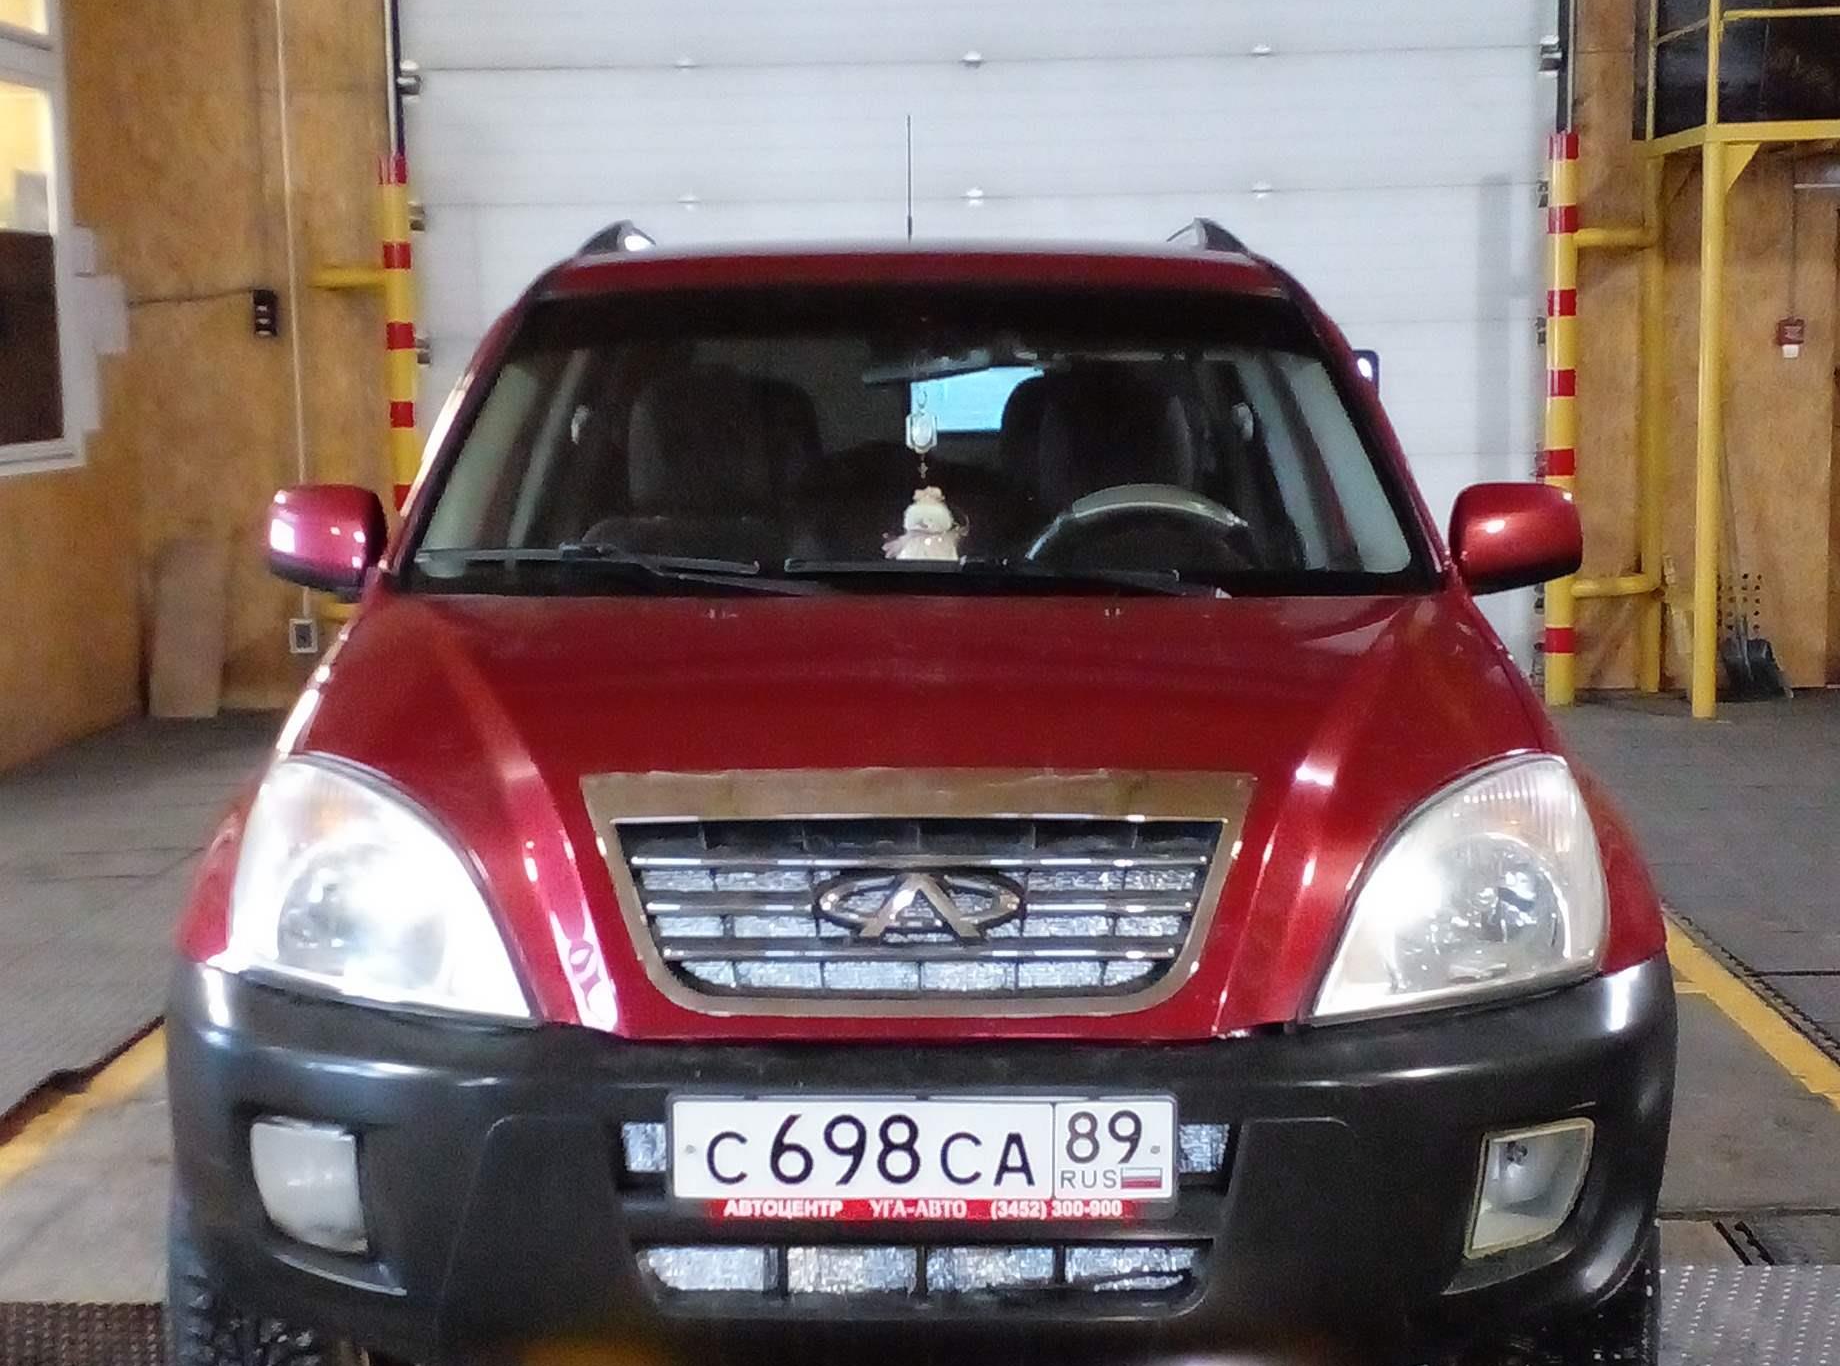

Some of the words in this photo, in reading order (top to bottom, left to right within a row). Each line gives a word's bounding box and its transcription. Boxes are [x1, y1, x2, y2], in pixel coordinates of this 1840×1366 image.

[1066, 1110, 1142, 1164] 89
[1060, 1169, 1117, 1189] RUS
[723, 1198, 843, 1218] АВТОЦЕНТР
[868, 1199, 967, 1219] УГА-АВТО
[990, 1200, 1047, 1220] (3452)
[1051, 1199, 1123, 1218] 300-900
